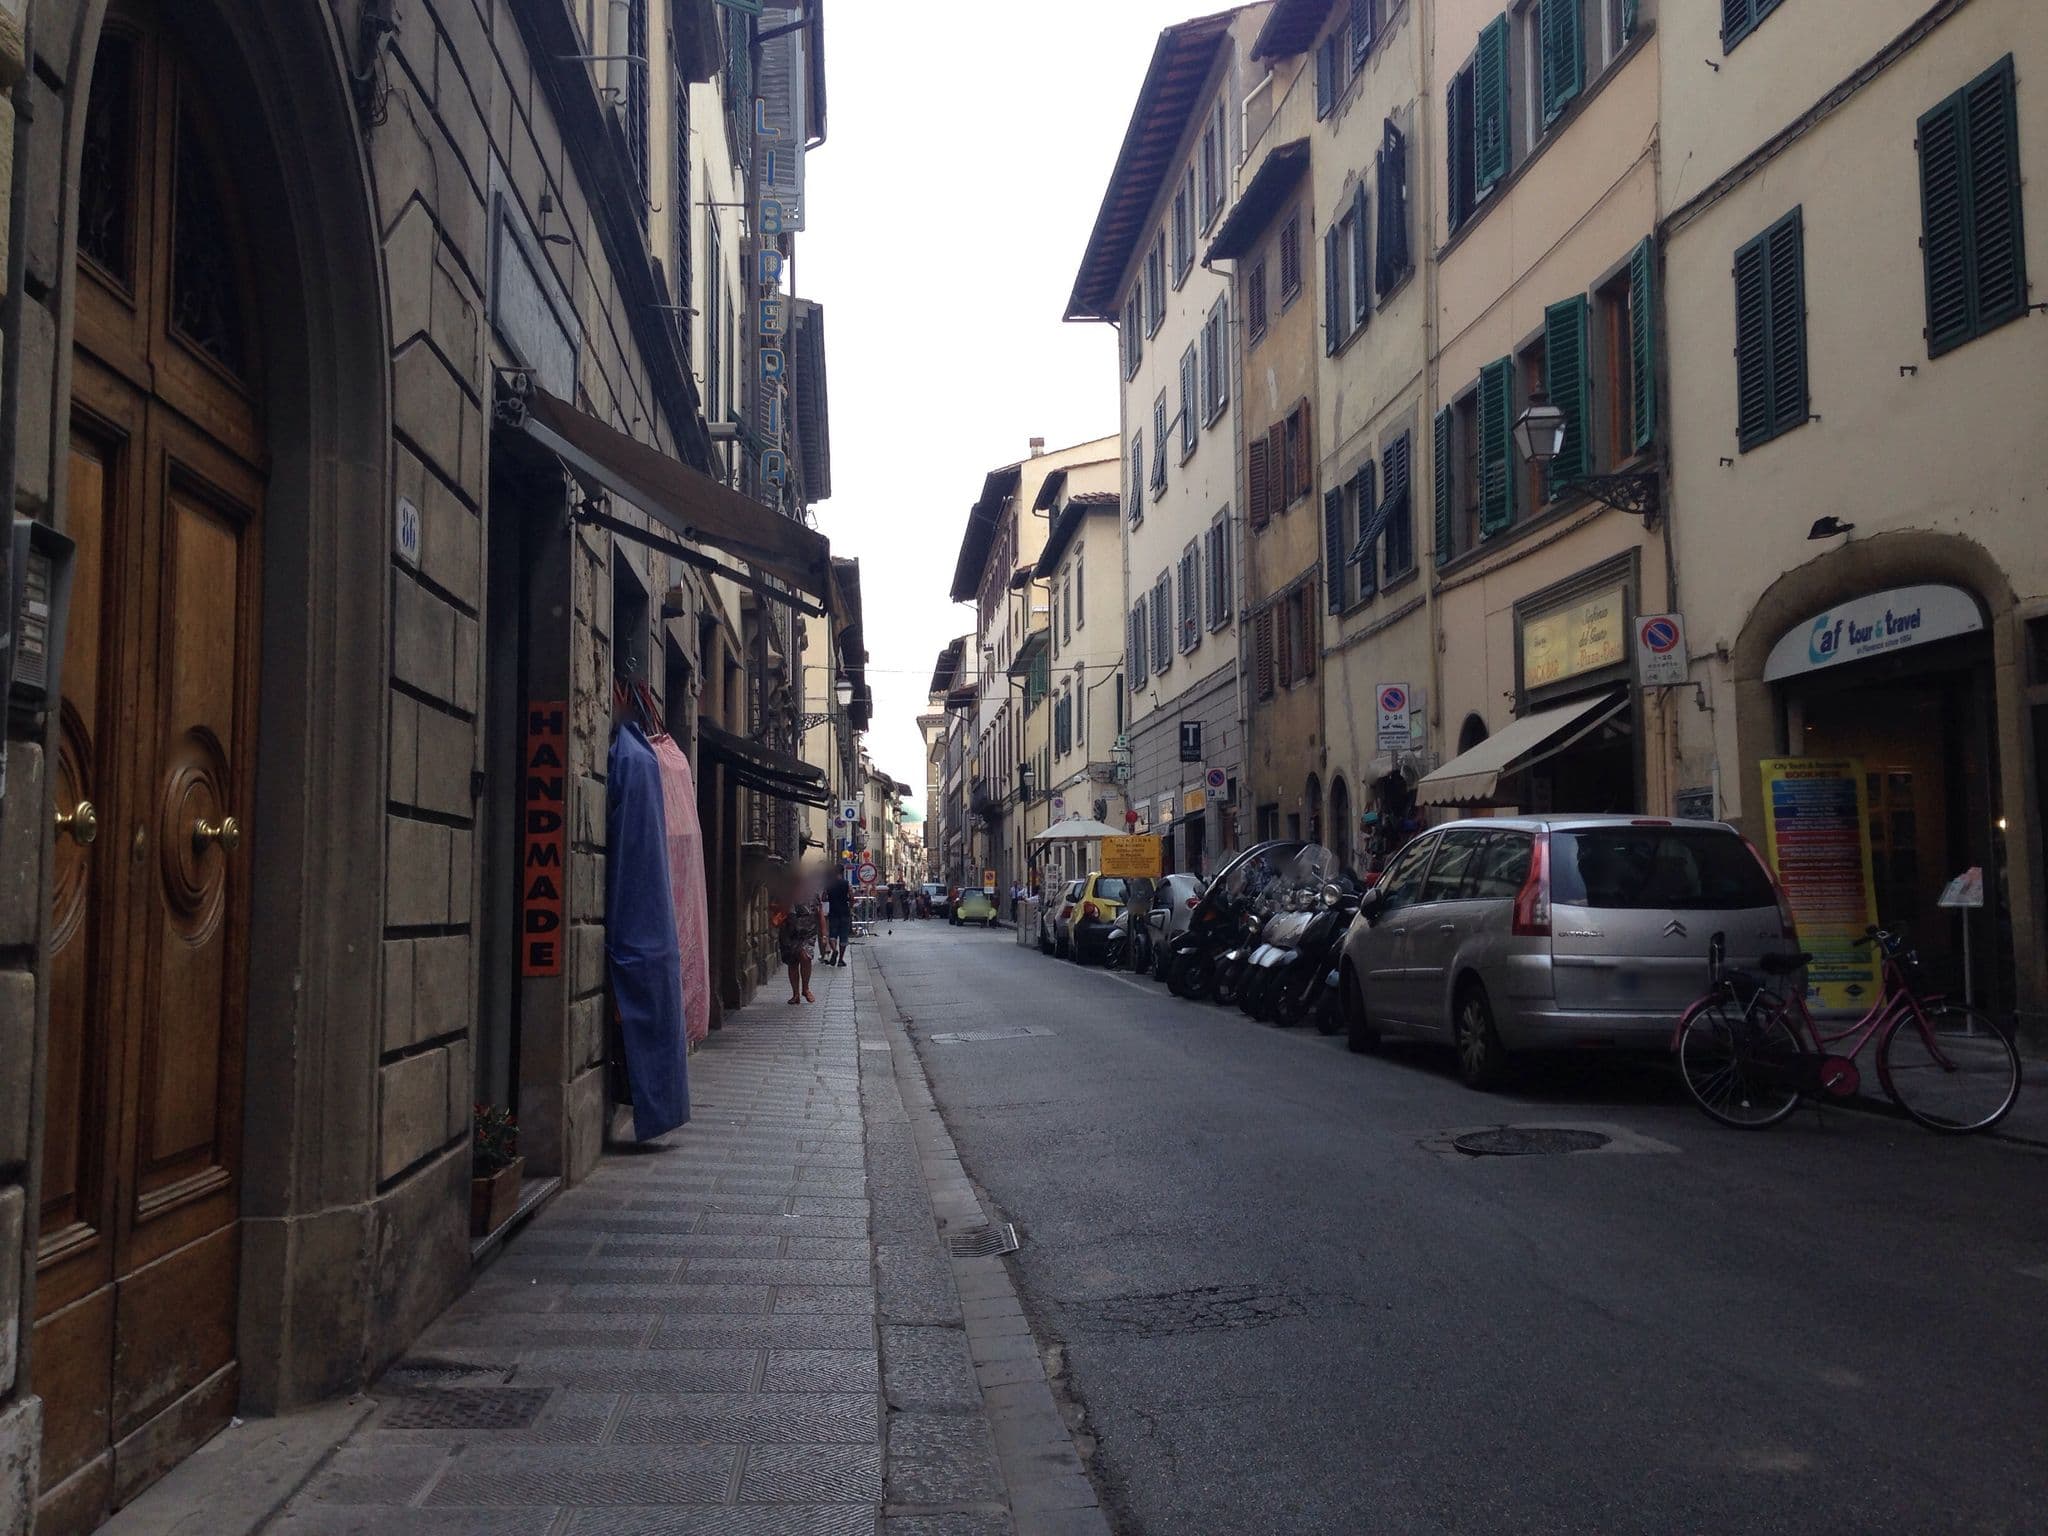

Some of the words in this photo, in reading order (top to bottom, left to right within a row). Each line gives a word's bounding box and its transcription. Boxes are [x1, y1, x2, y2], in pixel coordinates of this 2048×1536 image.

[755, 98, 786, 486] LIBRERIA
[1848, 620, 1874, 645] tour
[1885, 608, 1921, 635] travel
[1183, 724, 1198, 746] T
[526, 711, 563, 967] HANDMADE
